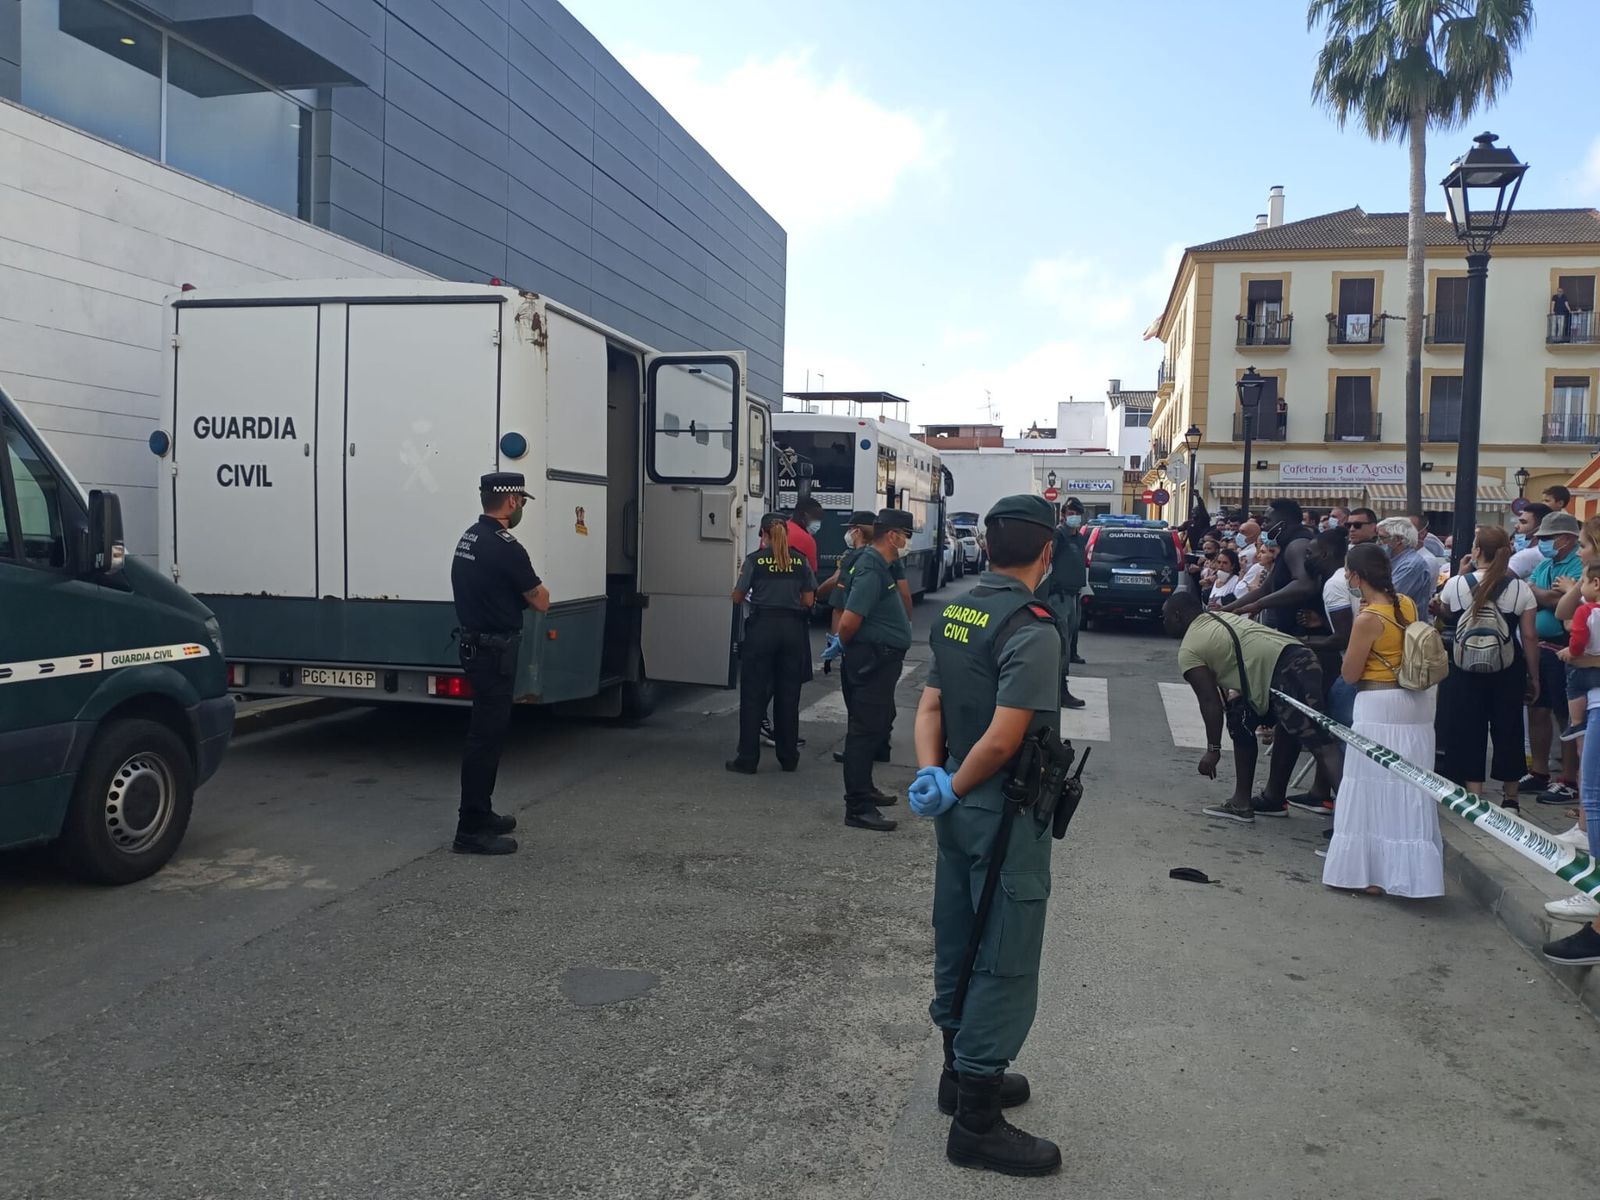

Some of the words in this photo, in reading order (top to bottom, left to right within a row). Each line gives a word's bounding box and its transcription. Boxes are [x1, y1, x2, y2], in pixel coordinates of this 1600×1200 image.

[193, 415, 297, 440] GUARDIA
[216, 463, 273, 488] CIVIL
[1332, 465, 1344, 475] 15
[1346, 463, 1359, 474] de
[1361, 463, 1404, 477] Agosto
[757, 557, 802, 566] GUADIA
[942, 604, 990, 628] GUARDIA
[943, 622, 969, 643] CIVIL
[111, 652, 151, 665] GUARDIA
[153, 649, 173, 660] CIVIL
